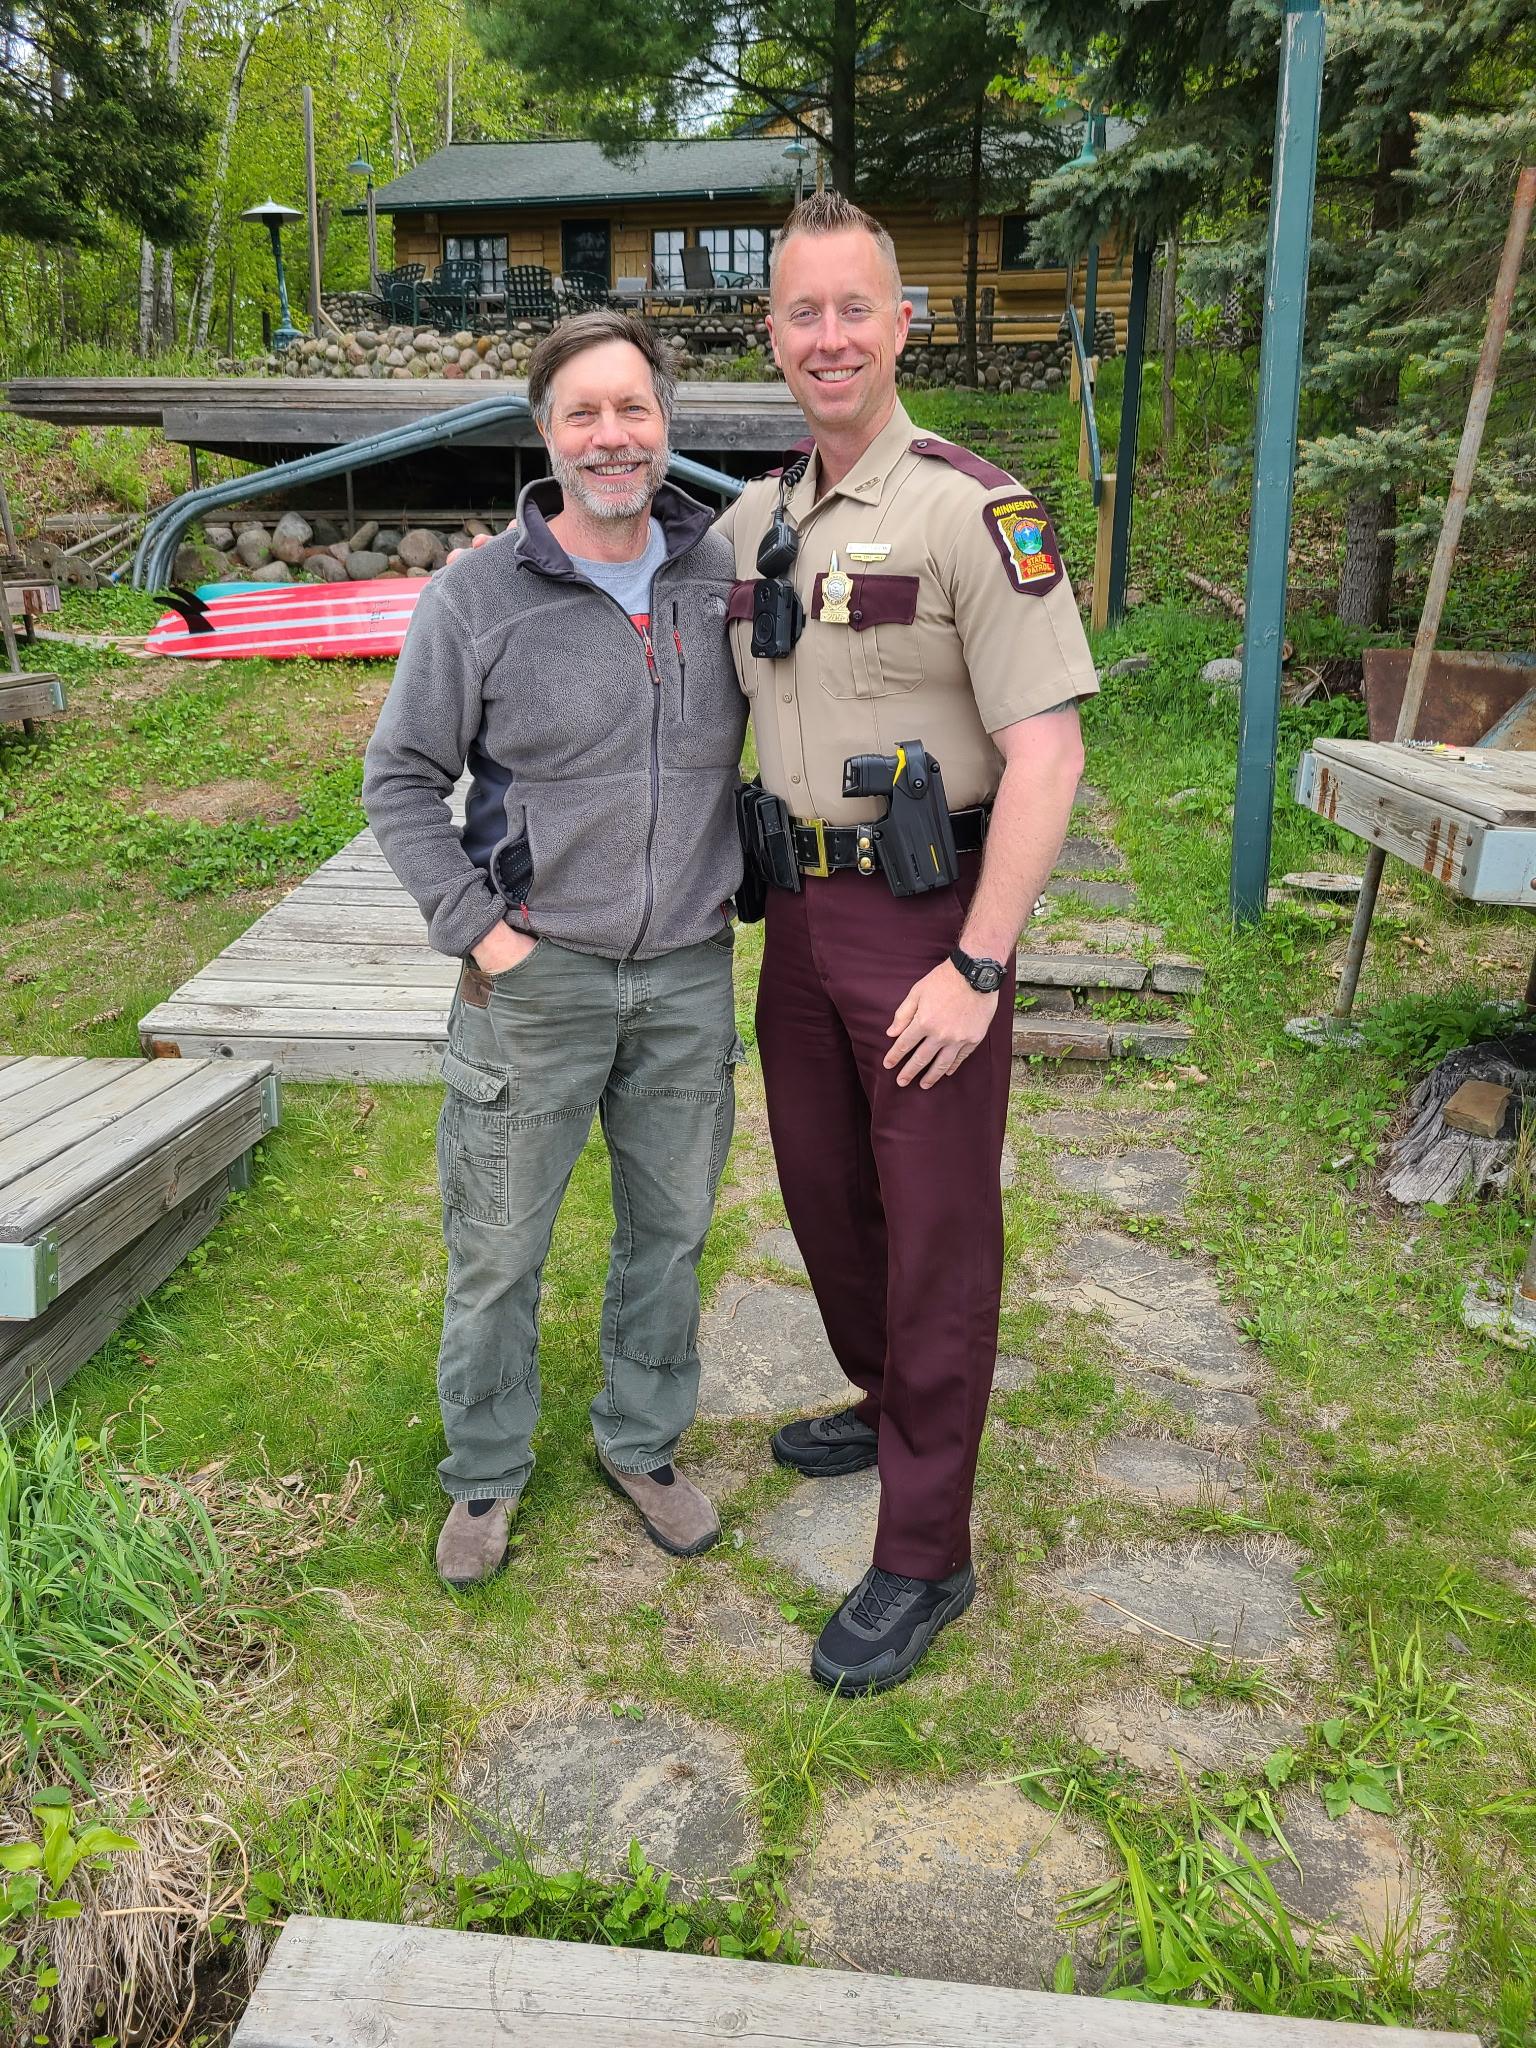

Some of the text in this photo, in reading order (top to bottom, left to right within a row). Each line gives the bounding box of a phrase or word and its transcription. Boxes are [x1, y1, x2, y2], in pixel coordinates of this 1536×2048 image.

[992, 500, 1038, 517] MINNESOTA
[1026, 555, 1046, 566] STATE
[1027, 562, 1051, 575] PATROL
